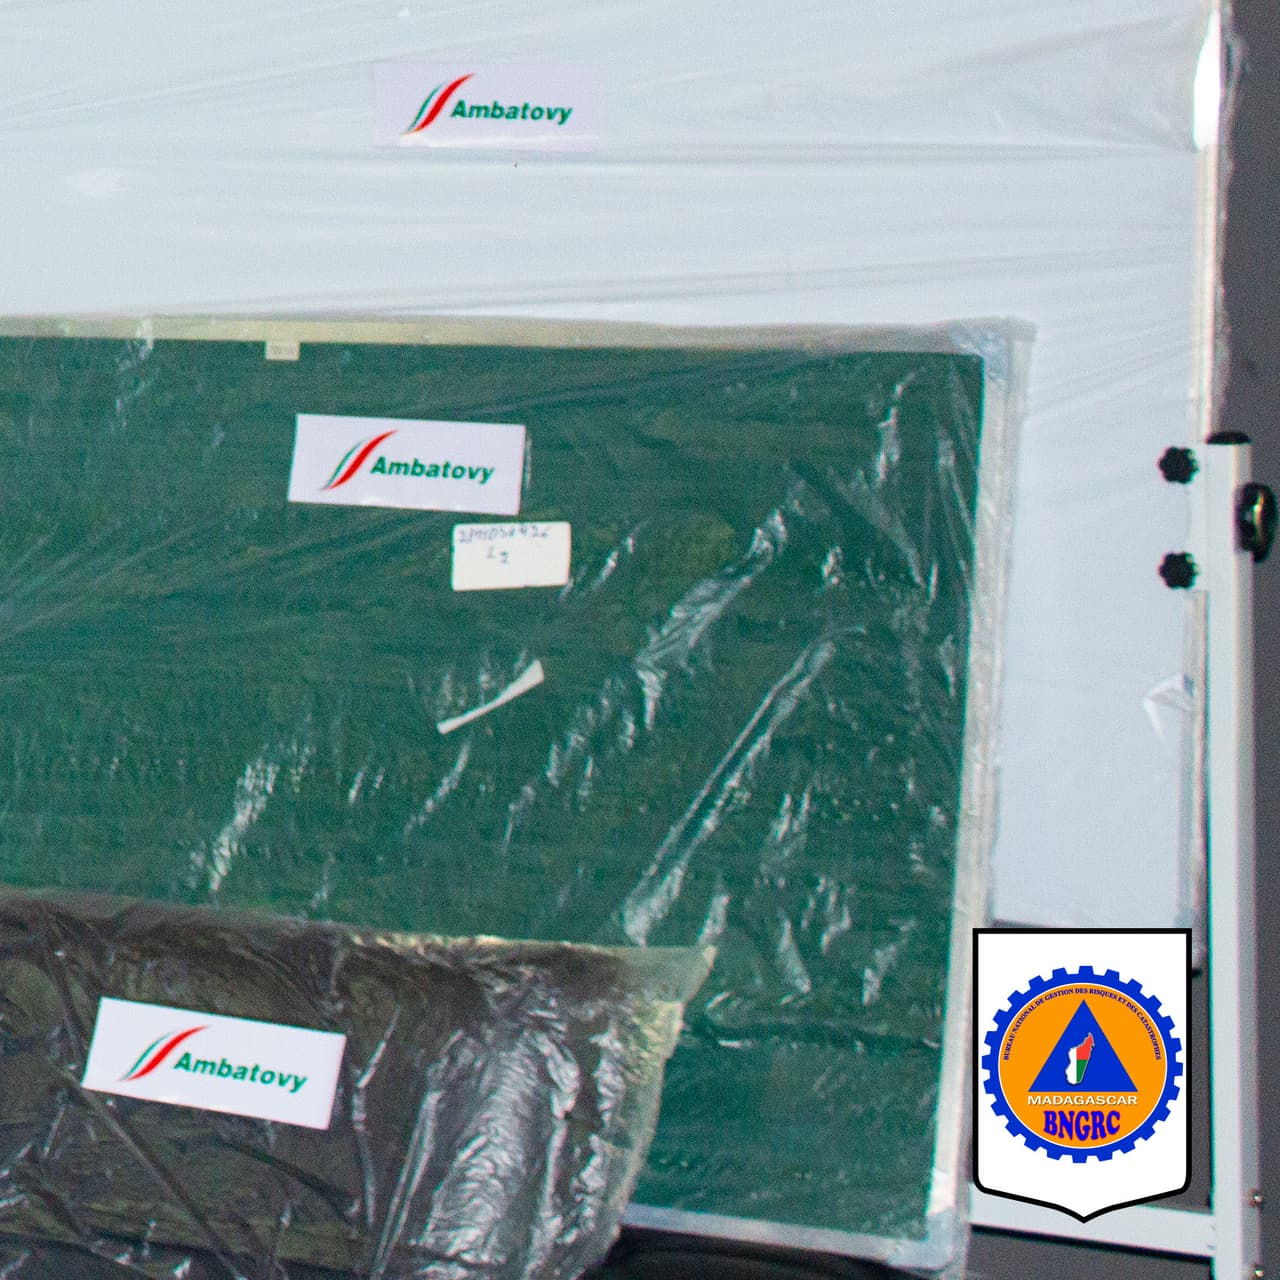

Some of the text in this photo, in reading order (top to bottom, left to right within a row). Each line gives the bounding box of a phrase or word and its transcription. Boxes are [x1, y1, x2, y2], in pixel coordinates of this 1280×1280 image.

[450, 99, 573, 125] Ambatovy
[370, 456, 495, 485] Ambatovy
[173, 1052, 308, 1094] Ambatovy
